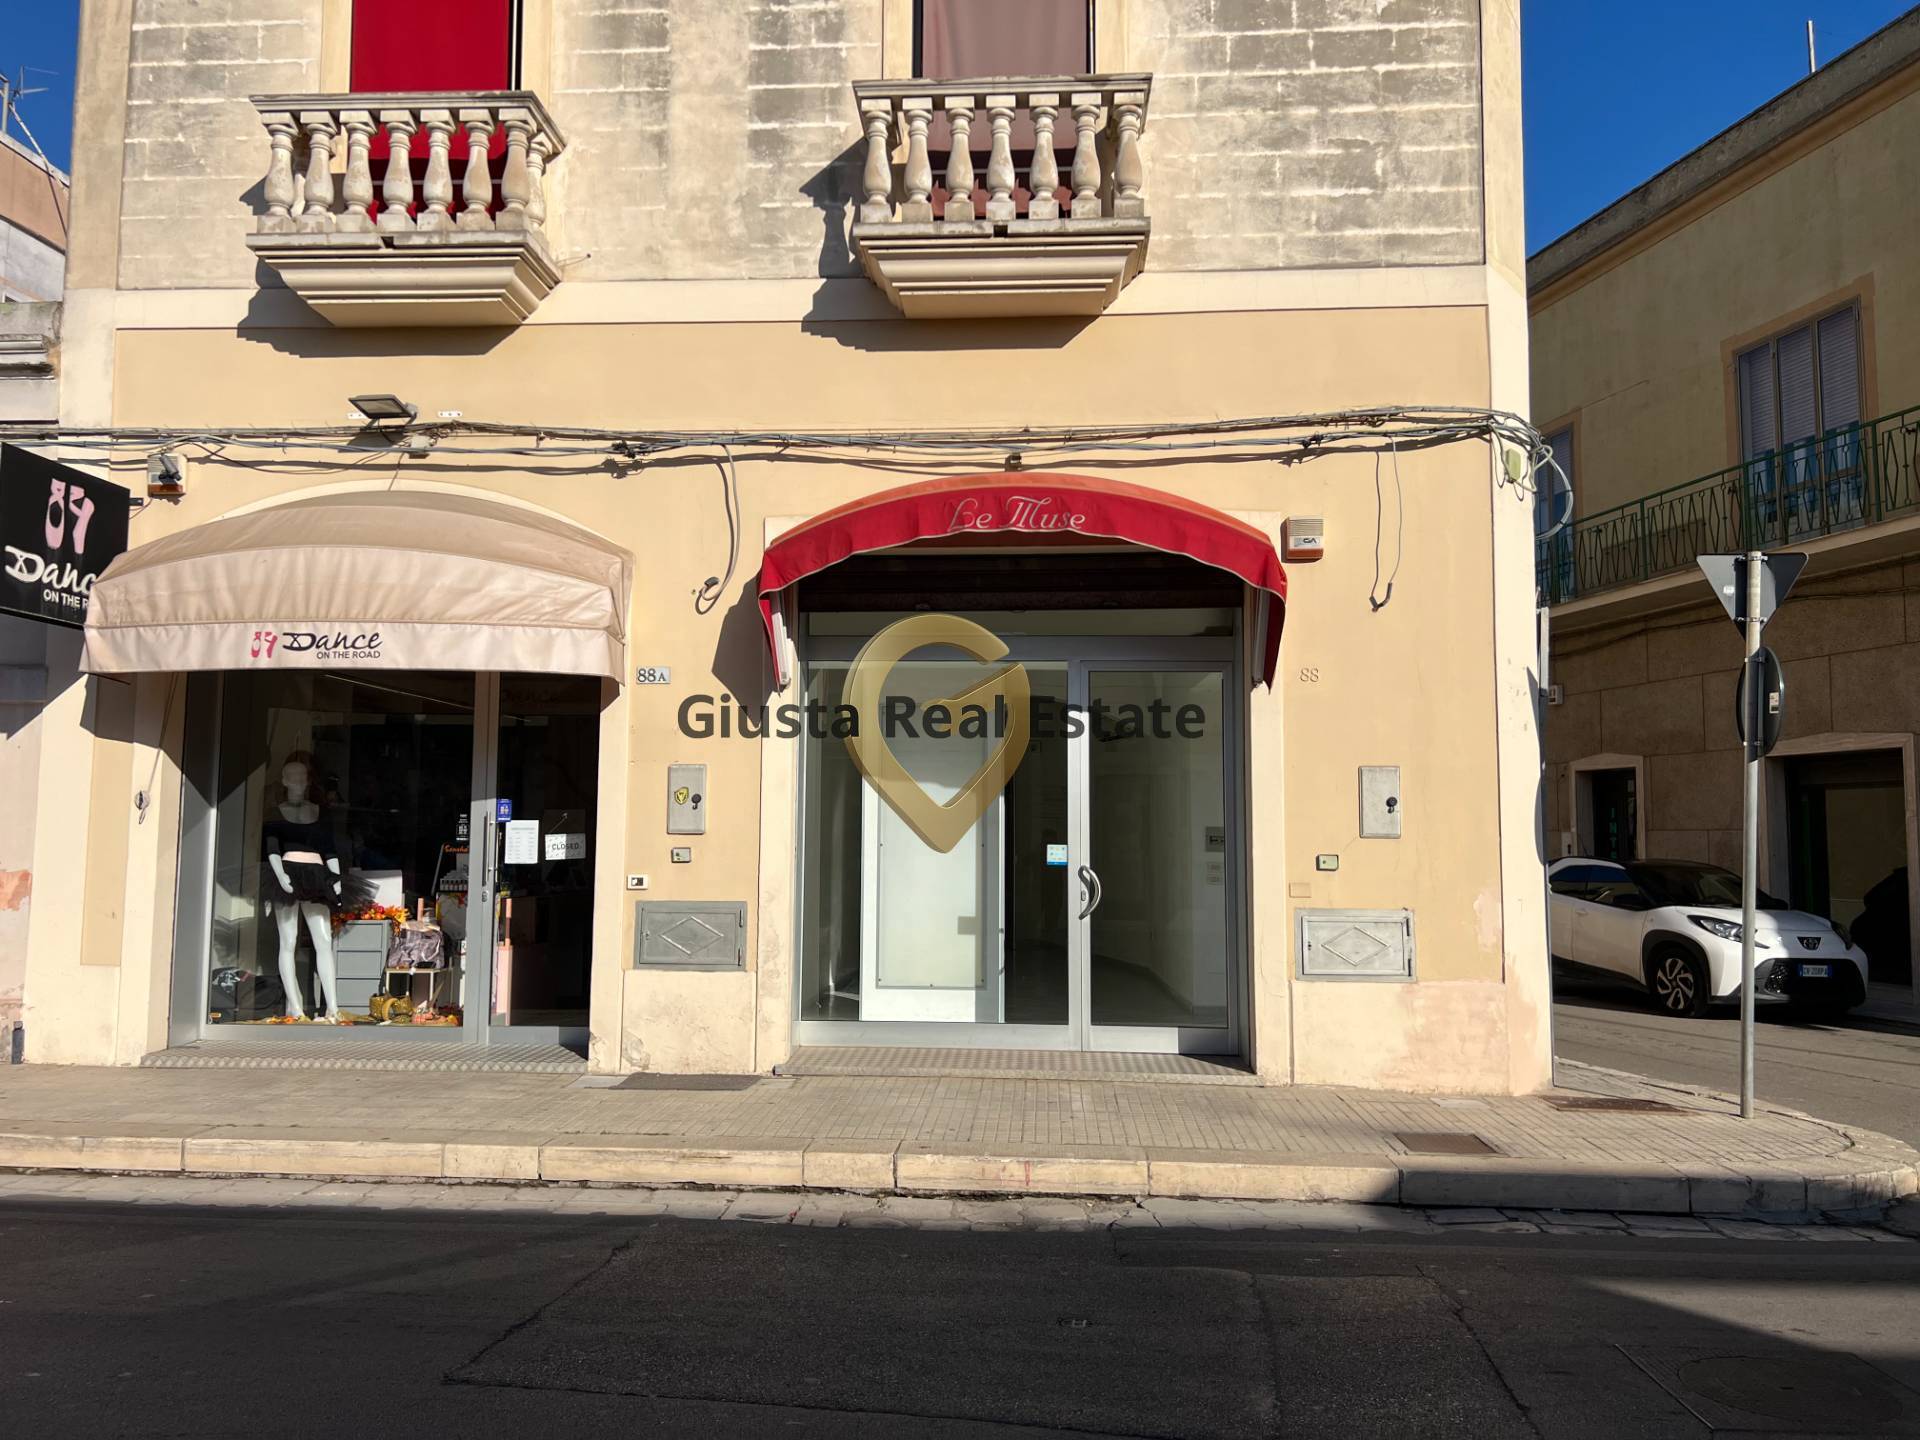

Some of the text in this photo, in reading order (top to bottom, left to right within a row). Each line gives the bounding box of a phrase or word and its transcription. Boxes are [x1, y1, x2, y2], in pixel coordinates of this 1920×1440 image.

[946, 495, 1086, 532] Le Muse
[4, 545, 98, 596] Danc
[43, 589, 59, 604] ON
[60, 592, 81, 609] THE
[282, 631, 383, 651] Dance
[316, 650, 381, 659] ON THE ROAD
[552, 841, 580, 851] CLOSED
